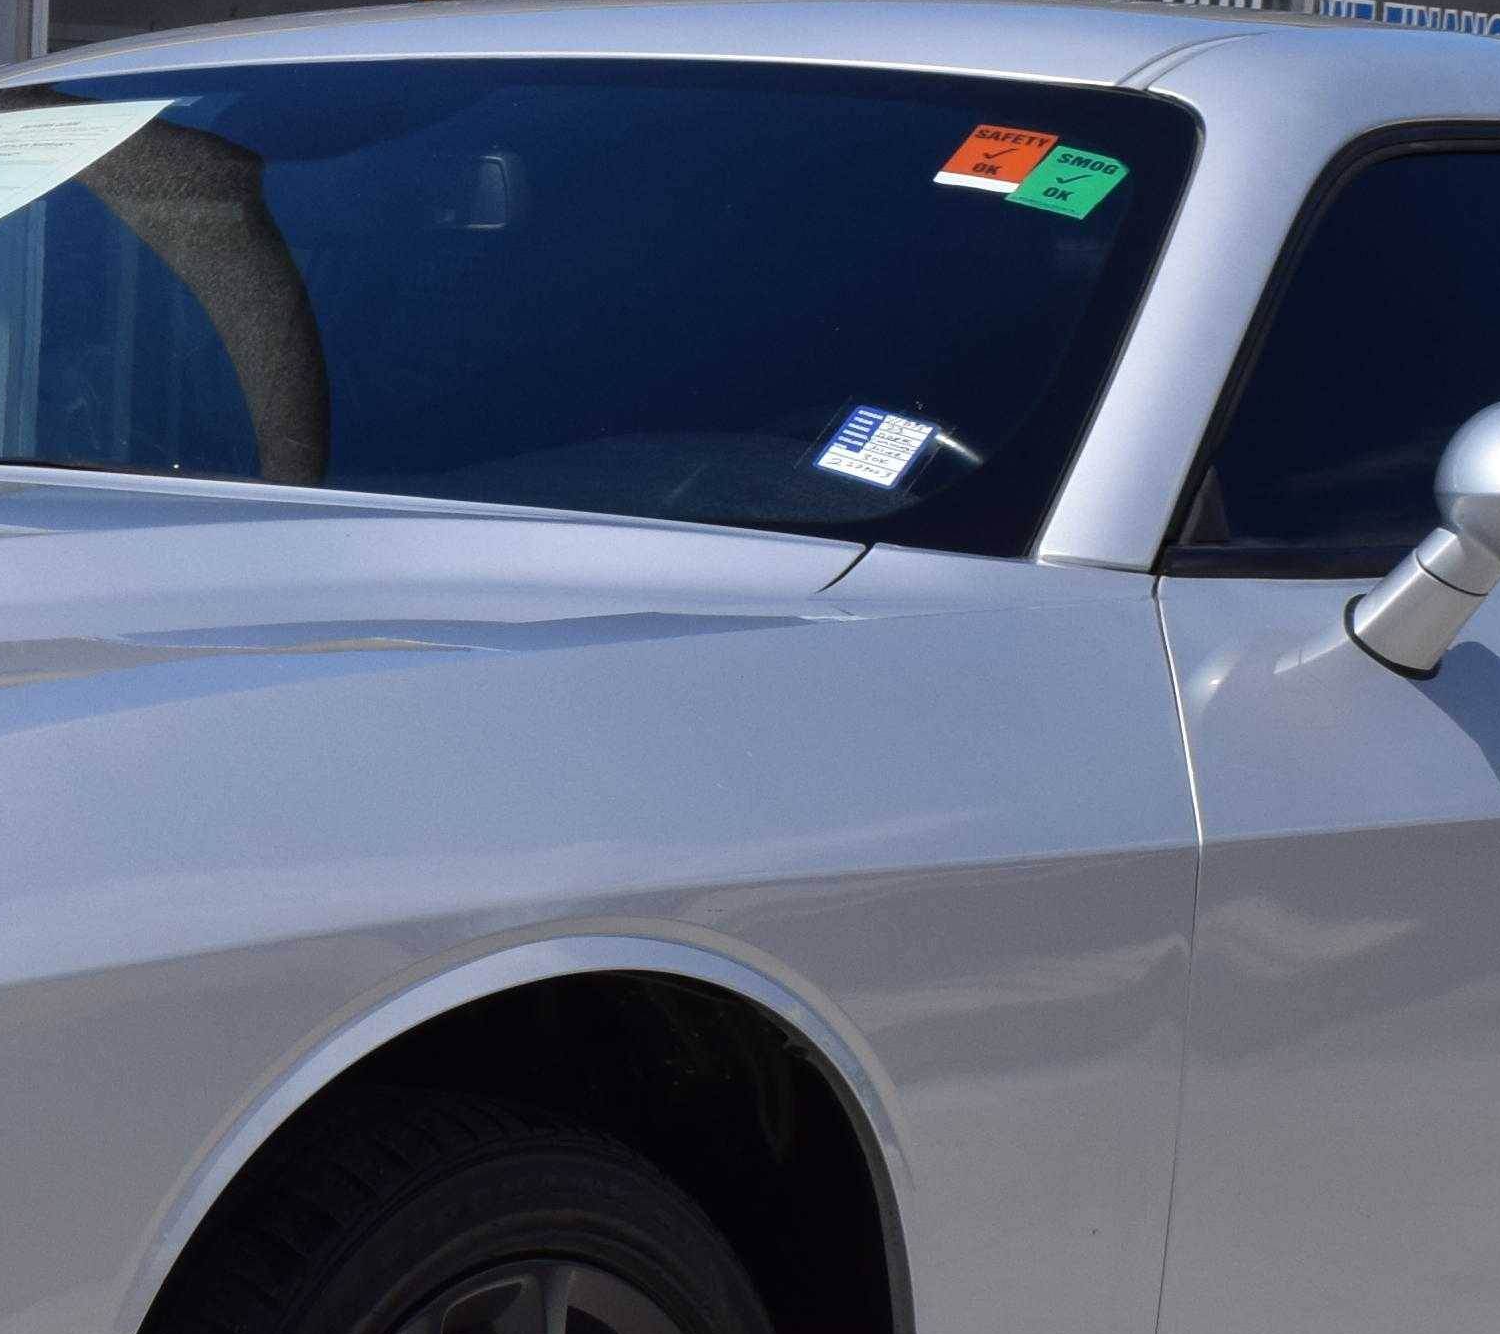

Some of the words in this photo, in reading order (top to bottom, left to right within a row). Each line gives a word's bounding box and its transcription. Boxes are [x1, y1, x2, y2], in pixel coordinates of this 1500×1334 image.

[974, 129, 1050, 148] SAFETY
[971, 162, 1003, 176] OK
[1056, 152, 1120, 176] SMOG
[1042, 186, 1075, 202] OK
